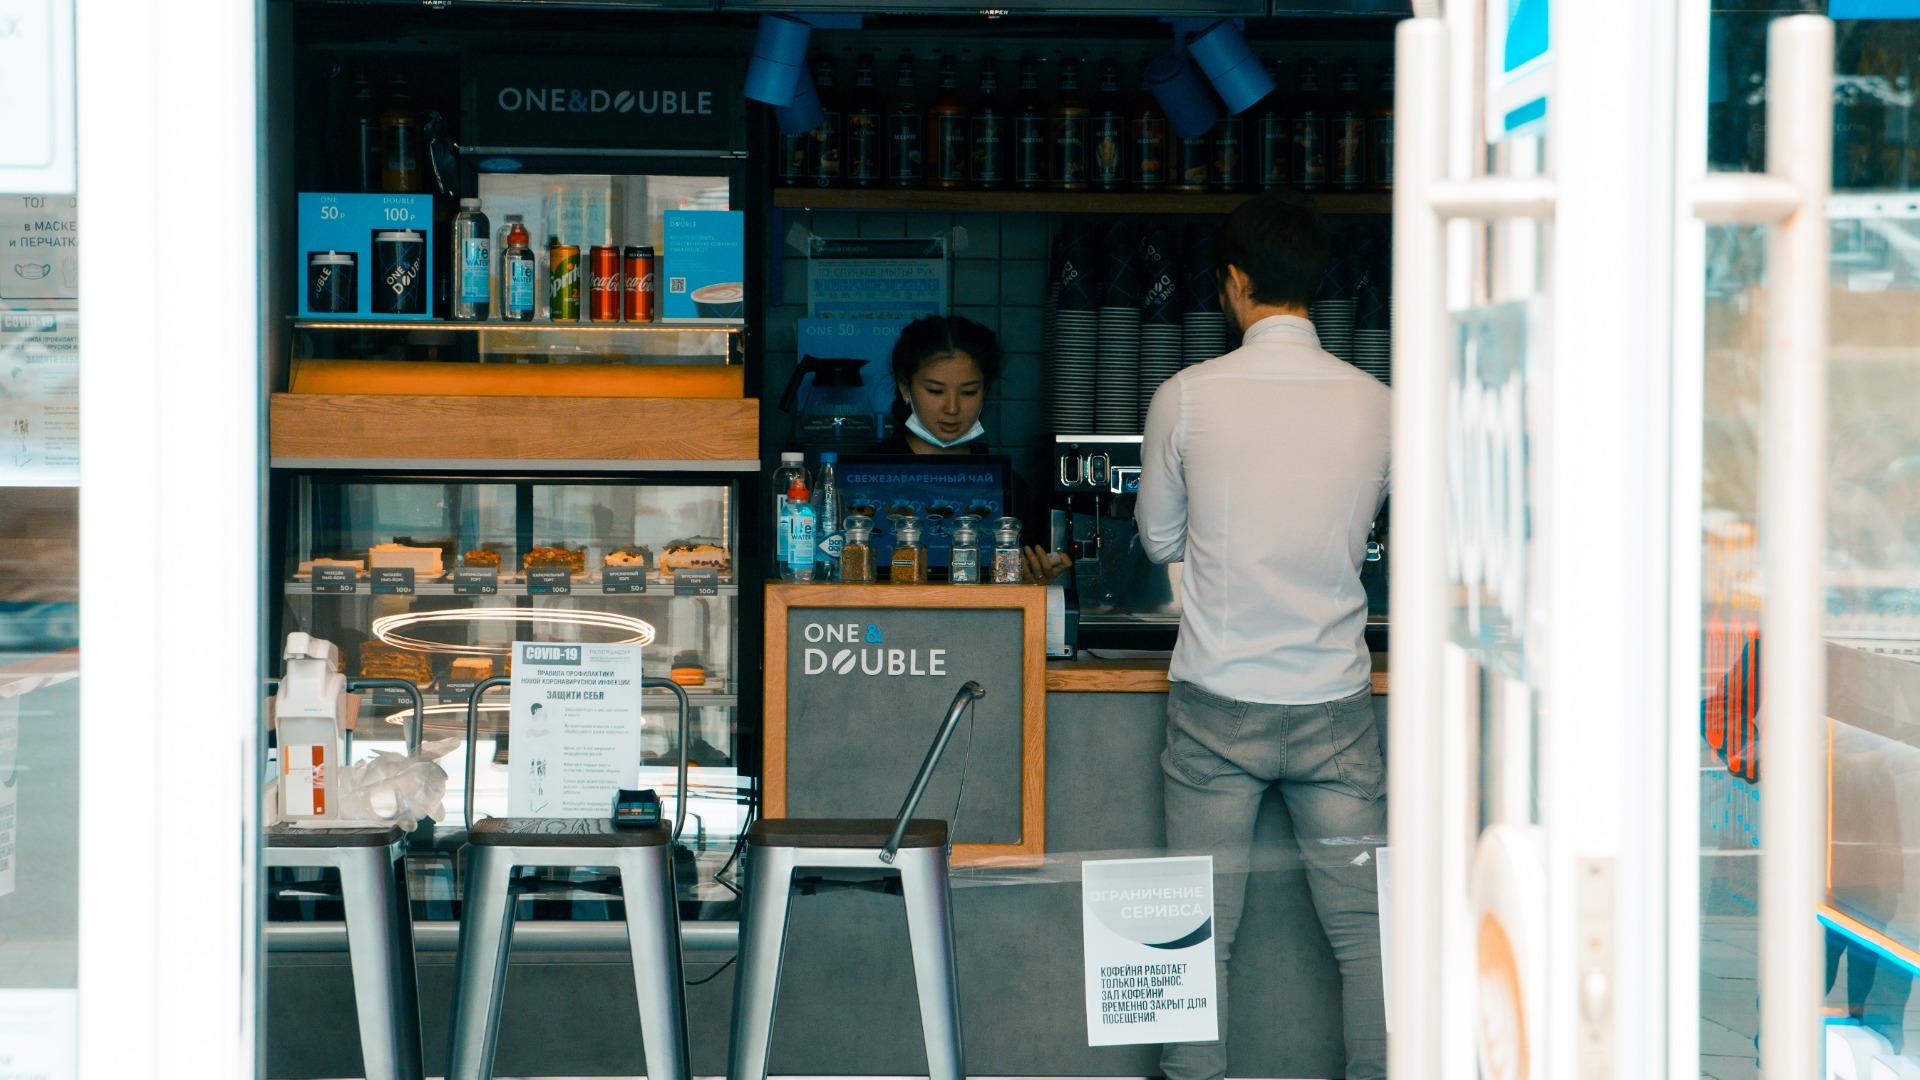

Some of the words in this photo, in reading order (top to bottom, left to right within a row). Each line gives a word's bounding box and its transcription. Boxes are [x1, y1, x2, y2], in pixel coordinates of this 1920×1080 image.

[34, 221, 77, 231] МАСКЕ
[20, 237, 78, 247] ПЕРЧАТК
[806, 326, 833, 336] ONE
[872, 326, 900, 336] DOU
[968, 472, 994, 483] ЧАЙ
[804, 623, 859, 643] ONE
[864, 623, 884, 644] &
[526, 646, 578, 661] COVID-19
[804, 648, 947, 676] DOUBLE
[542, 677, 597, 685] КОРОНАВИРУСНОЙ
[546, 690, 581, 701] ЗАЩИТИ
[583, 691, 604, 701] СЕБЯ
[1089, 886, 1205, 902] ОГРАНИЧЕНИЕ
[1121, 904, 1205, 919] СЕРИВСА
[1100, 963, 1143, 977] КОФЕЙНЯ
[1144, 963, 1187, 975] РАБОТАЕТ
[1101, 977, 1135, 988] ТОЛЬКО
[1137, 977, 1149, 988] НА
[1151, 976, 1184, 987] ВЫНОС.
[1102, 989, 1120, 1000] ЗАЛ
[1121, 985, 1164, 999] КОФЕЙНИ
[1102, 1000, 1148, 1012] ВРЕМЕННО
[1150, 999, 1184, 1009] ЗАКРЫТ
[1187, 997, 1207, 1010] ДЛЯ
[1102, 1012, 1158, 1024] ПОСЕЩЕНИЯ.
